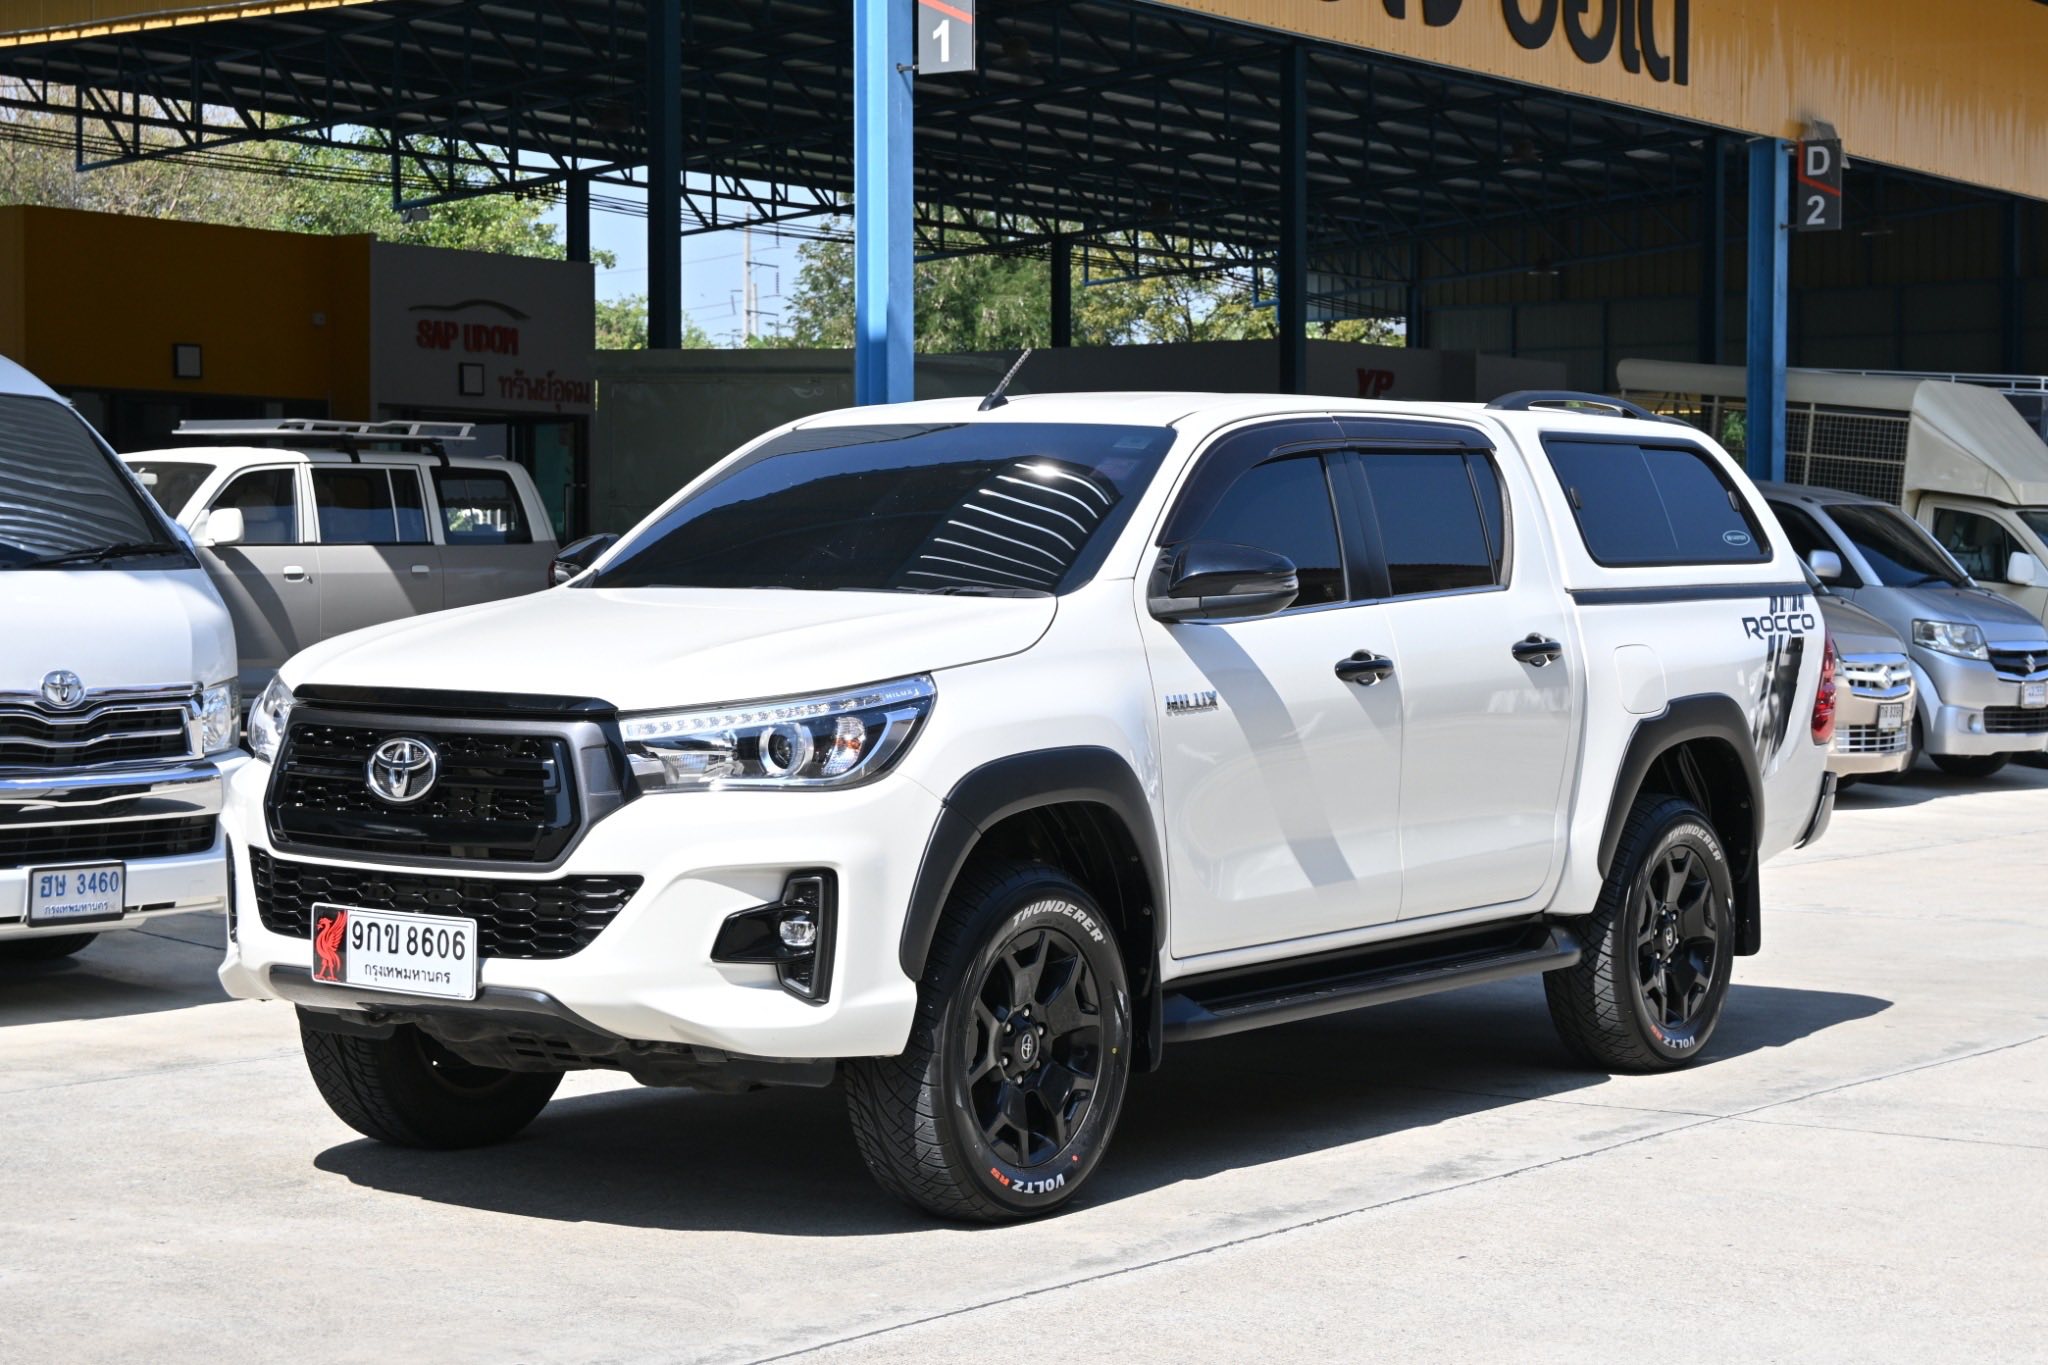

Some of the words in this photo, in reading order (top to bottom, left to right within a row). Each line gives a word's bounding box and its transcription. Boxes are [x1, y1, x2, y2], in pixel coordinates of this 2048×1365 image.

[932, 19, 950, 63] 1
[1807, 145, 1830, 176] D
[1806, 195, 1825, 225] 2
[417, 320, 459, 350] SAP
[463, 324, 520, 357] UDOM
[498, 368, 591, 412] ทรัพย์อุดม
[1356, 367, 1395, 398] YP
[1741, 613, 1815, 640] ROCCO
[1165, 690, 1219, 711] HILUX
[1668, 823, 1722, 861] THUNDERER
[40, 874, 66, 898] ฮษ
[76, 871, 119, 895] 3460
[44, 901, 108, 917] กรุงเทพมหานคร
[1012, 900, 1105, 943] THUNDERER
[352, 920, 400, 954] 9กข
[406, 925, 466, 961] 8606
[364, 962, 451, 984] กรุงเทพมหานคร
[1663, 1034, 1696, 1050] VOLTZ
[1011, 1173, 1066, 1195] VOLTZ
